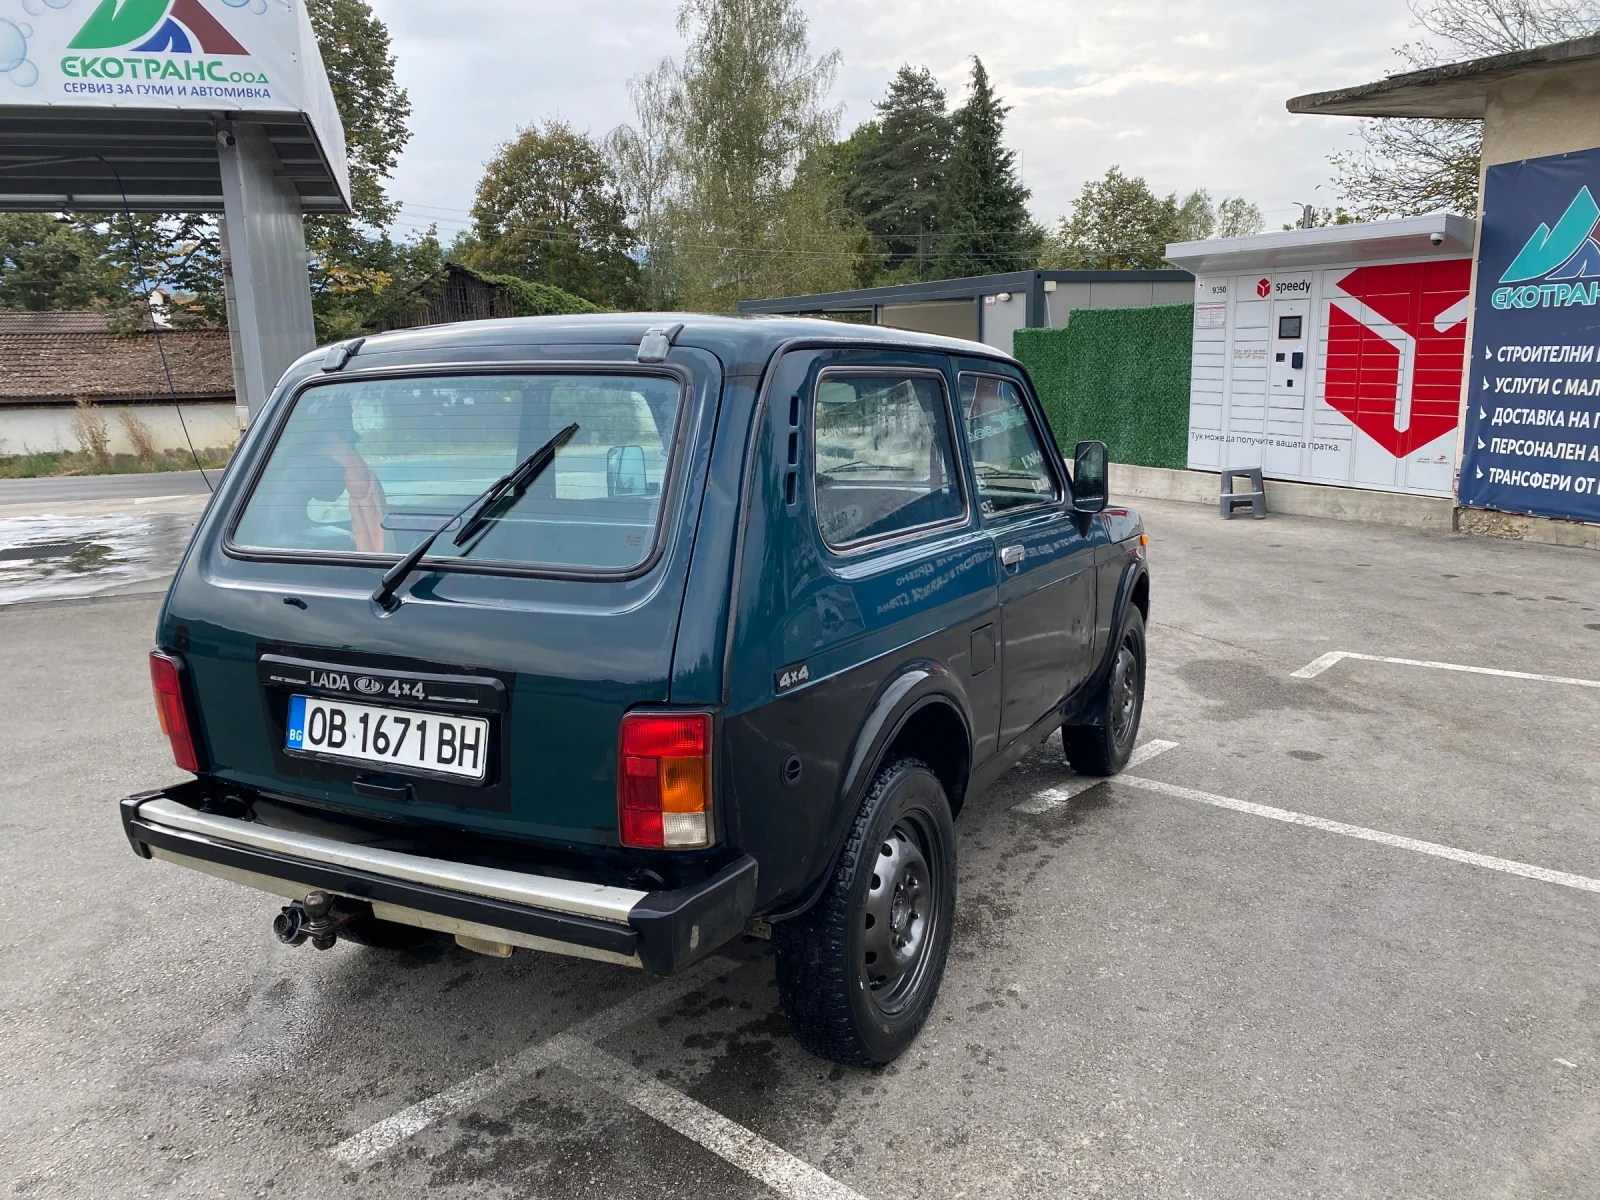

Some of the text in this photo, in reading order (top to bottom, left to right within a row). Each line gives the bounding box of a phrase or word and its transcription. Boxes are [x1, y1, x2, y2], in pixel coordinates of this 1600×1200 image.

[63, 82, 271, 99] СЕРВИЗ ЗА ГУМИ И АВТОМИВКА
[1275, 279, 1311, 294] speedy
[1497, 346, 1594, 363] СТРОИТЕЛНИ
[1494, 377, 1550, 395] УСЛУГИ
[1552, 378, 1563, 395] С
[1491, 407, 1565, 427] ДОСТАВКА
[1568, 411, 1590, 429] НА
[1191, 431, 1341, 452] Тук може да получите вашата пратка.
[1490, 437, 1586, 462] ПЕРСОНАЛЕН
[1489, 467, 1571, 492] ТРАНСФЕРИ
[1574, 477, 1596, 495] ОТ
[310, 670, 350, 691] LADA
[289, 729, 302, 741] BG
[308, 706, 481, 769] OB 1671 BH
